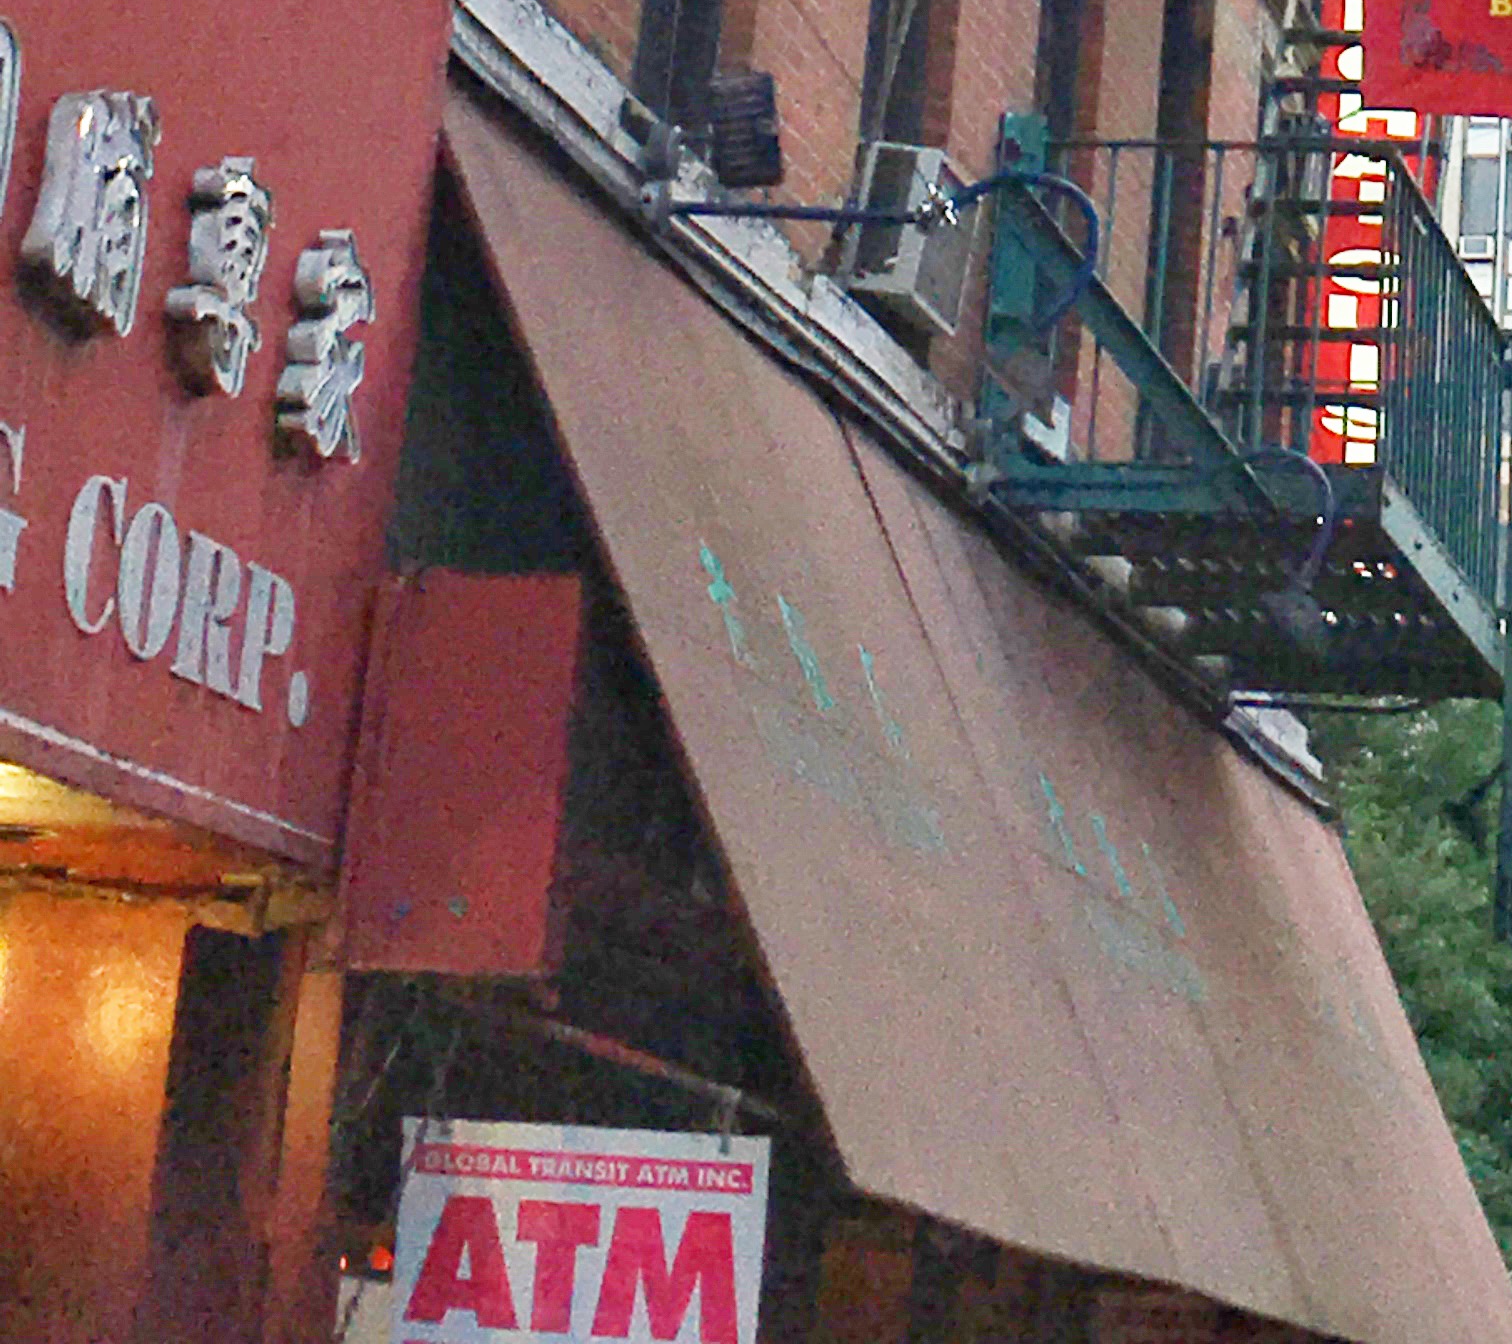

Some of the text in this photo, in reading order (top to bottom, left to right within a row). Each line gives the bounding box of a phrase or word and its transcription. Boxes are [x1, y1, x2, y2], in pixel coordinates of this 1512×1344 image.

[64, 474, 310, 728] CORP.
[424, 1148, 750, 1190] GLOBAL TRANSIT ATM INC.
[403, 1194, 739, 1344] ATM
